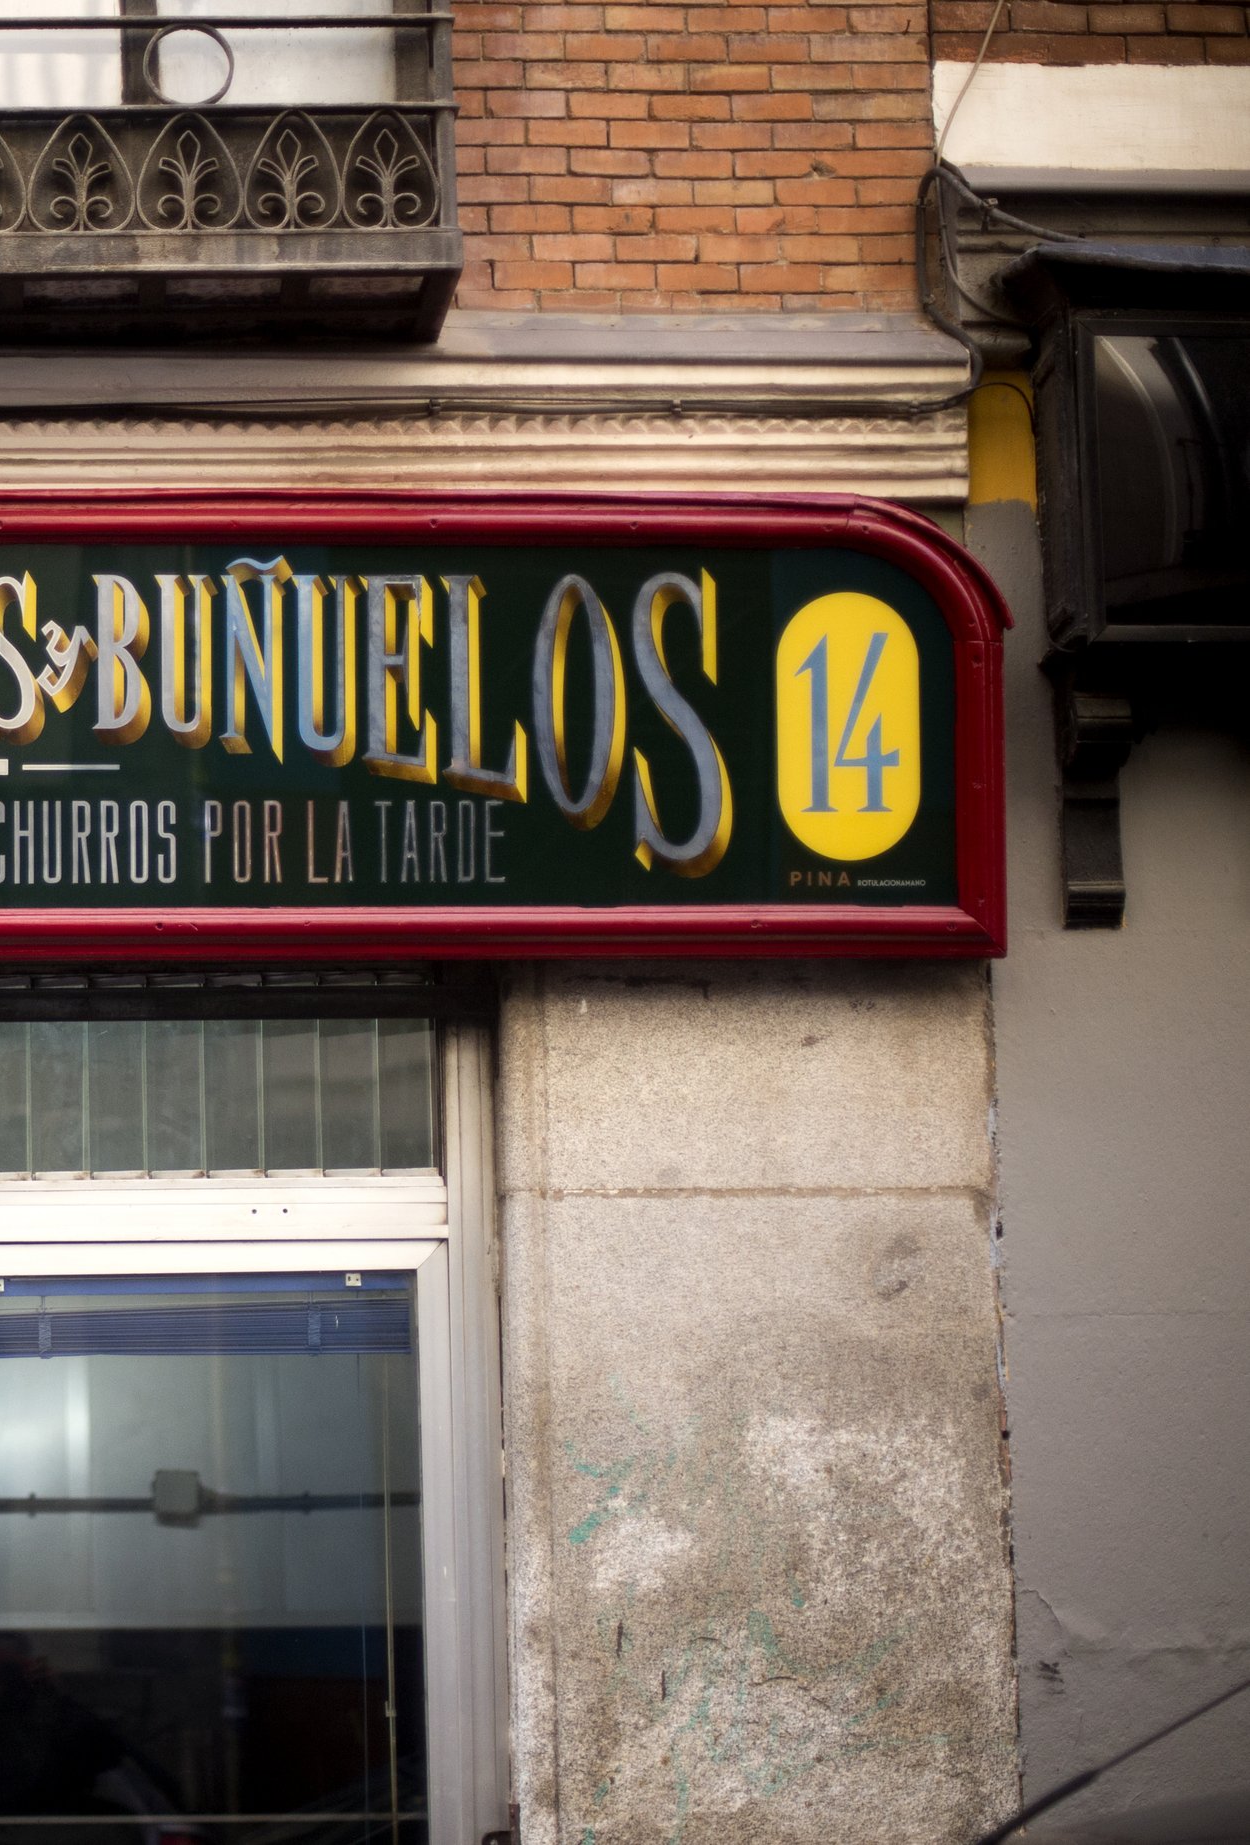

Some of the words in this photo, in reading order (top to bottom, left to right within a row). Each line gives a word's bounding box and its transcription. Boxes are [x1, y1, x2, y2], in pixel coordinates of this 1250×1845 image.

[36, 619, 98, 713] y
[91, 555, 733, 878] BUÑUELOS
[794, 631, 899, 813] 14
[204, 800, 283, 884] POR
[307, 800, 355, 884] LA
[374, 800, 506, 884] TARDE
[789, 871, 851, 887] PINA
